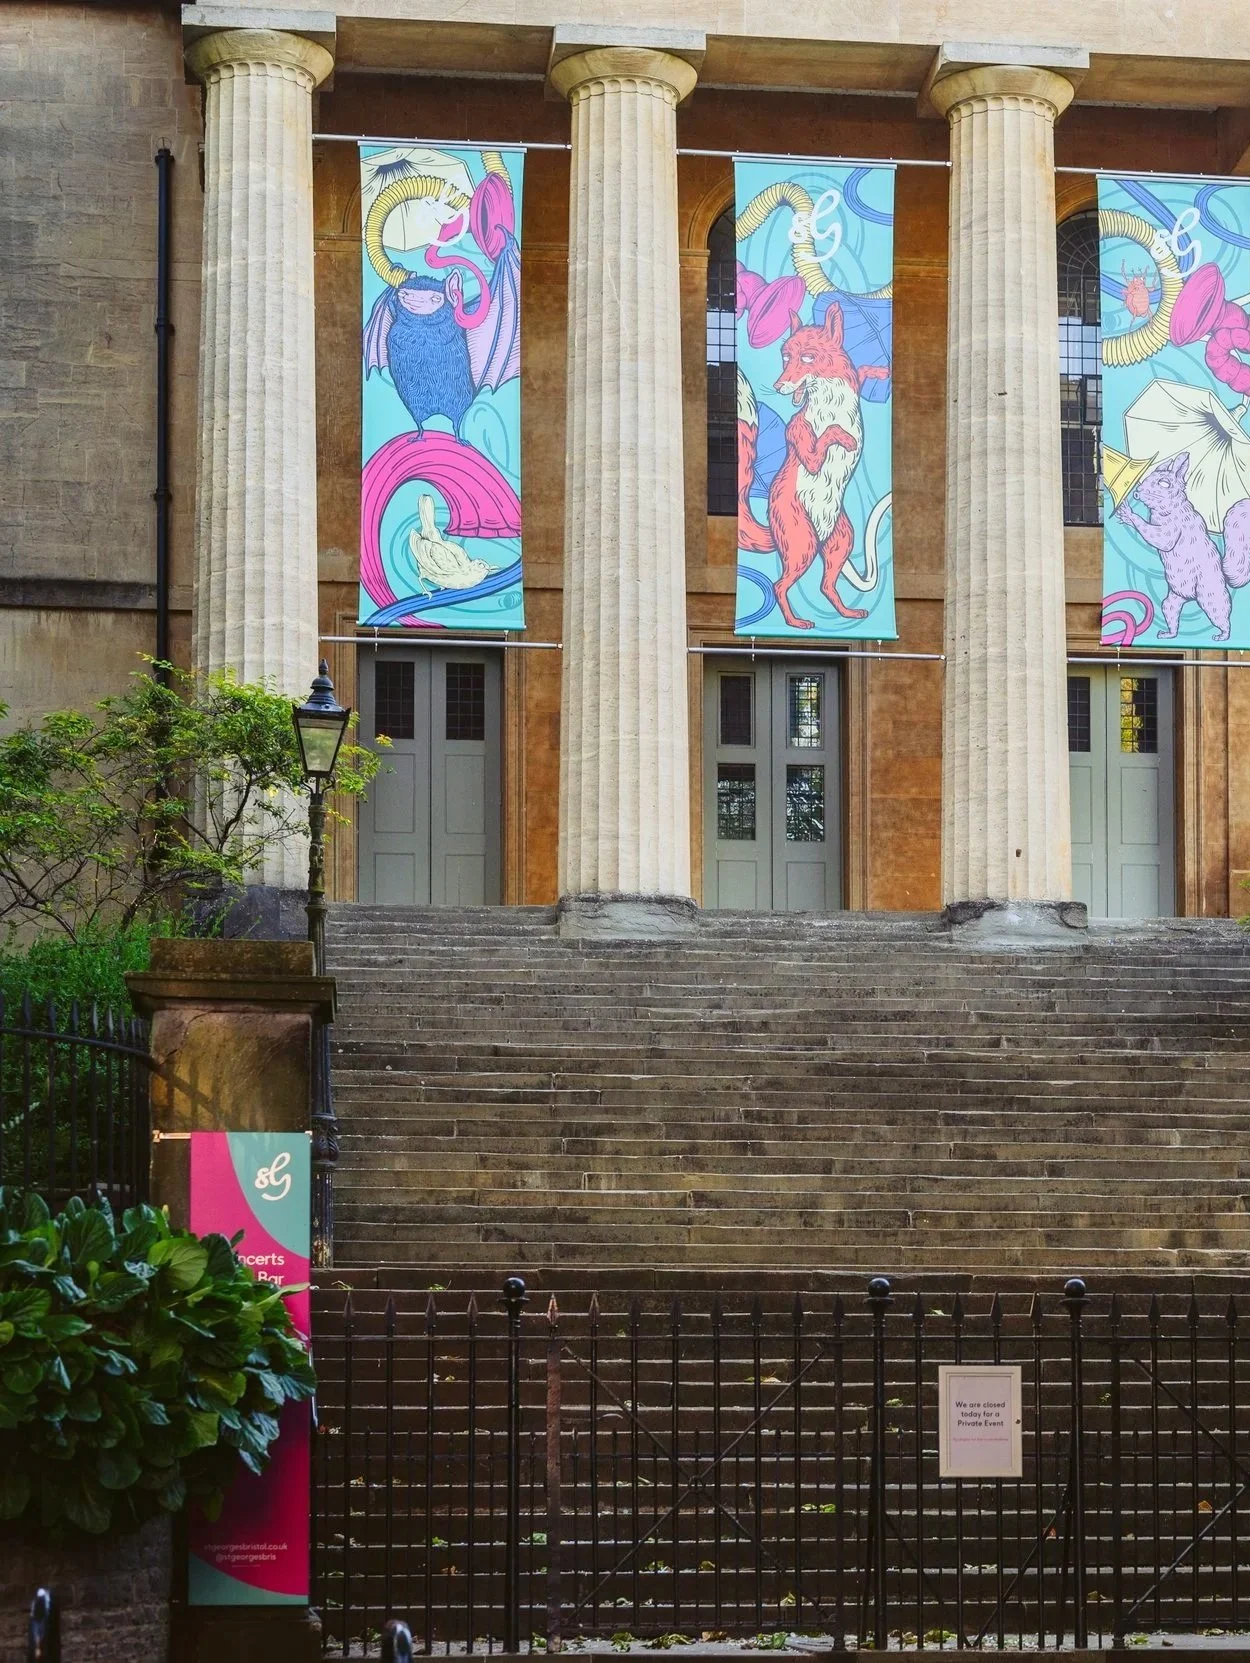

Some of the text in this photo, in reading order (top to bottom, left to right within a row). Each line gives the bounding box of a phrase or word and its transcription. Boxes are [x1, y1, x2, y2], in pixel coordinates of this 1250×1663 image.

[237, 1252, 285, 1266] ncerts
[961, 1410, 982, 1418] today
[983, 1410, 993, 1418] for
[957, 1419, 983, 1427] Private
